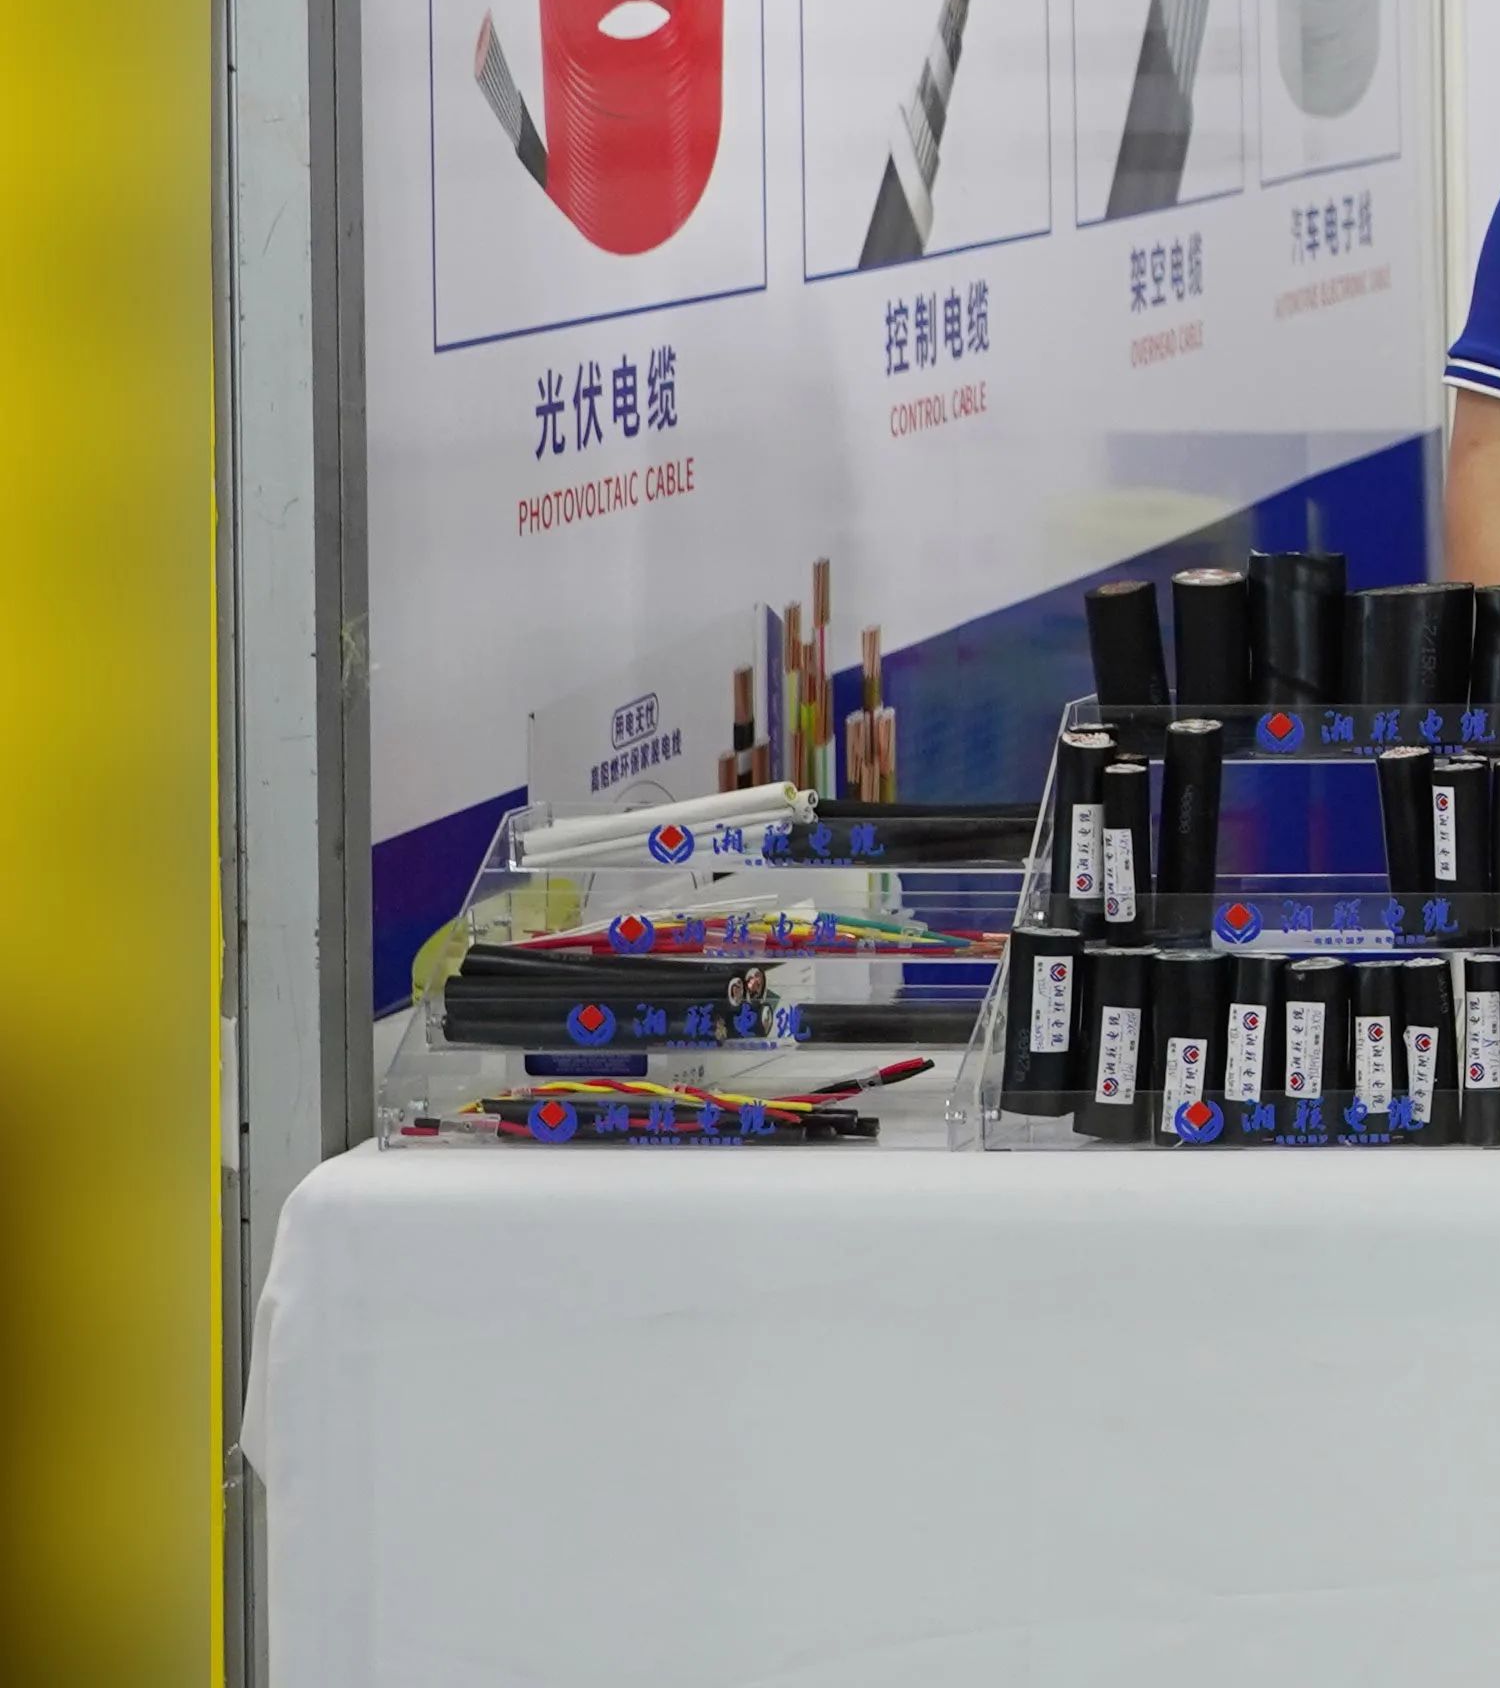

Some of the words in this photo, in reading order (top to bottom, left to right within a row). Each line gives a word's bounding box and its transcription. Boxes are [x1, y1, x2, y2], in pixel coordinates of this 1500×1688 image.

[1130, 232, 1202, 314] 架空电缆
[885, 282, 990, 377] 控制电缆
[535, 347, 679, 459] 光伏电缆
[890, 393, 945, 438] CONTROL
[950, 381, 988, 423] CABLE
[518, 471, 639, 537] PHOTOVOLTAIC
[646, 457, 695, 505] CABLE
[615, 700, 656, 737] 用电无忧
[1321, 709, 1496, 746] 湘联电缆
[590, 728, 682, 794] 高阻燃环保家装电线
[713, 823, 885, 857] 湘联电缆
[1281, 899, 1459, 934] 湘联电缆
[633, 1002, 812, 1043] 湘联电缆
[593, 1101, 775, 1137] 湘联电缆
[1241, 1096, 1426, 1134] 湘联电缆
